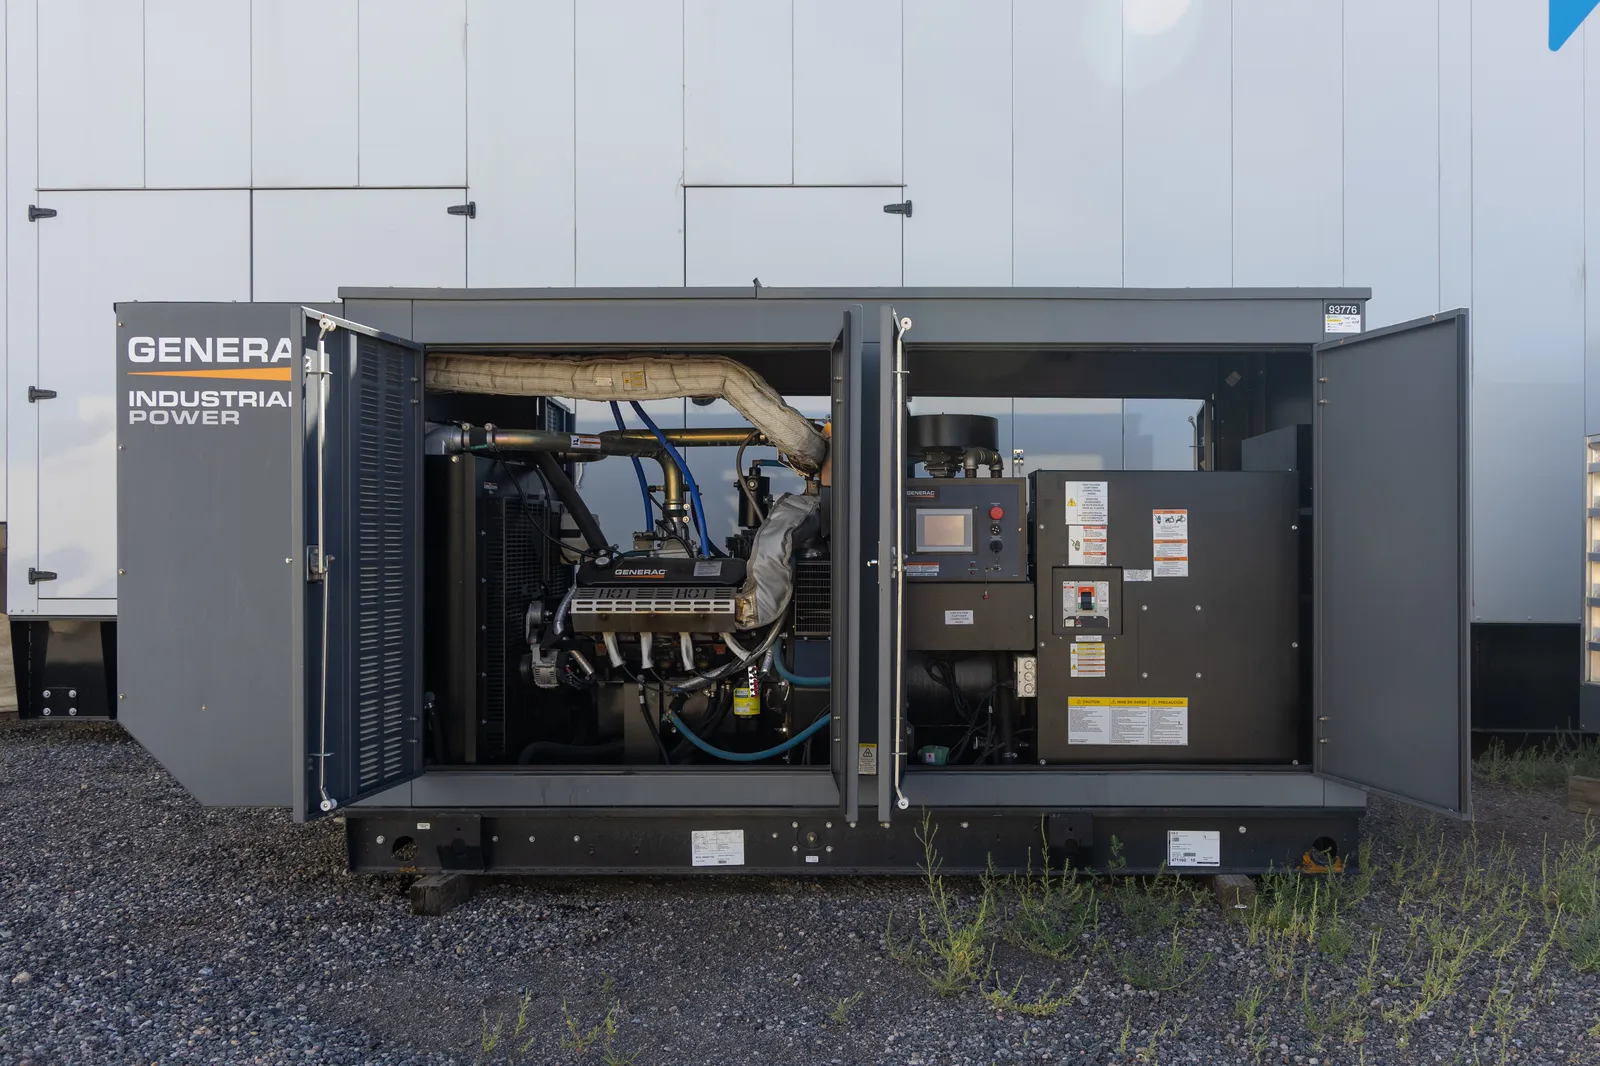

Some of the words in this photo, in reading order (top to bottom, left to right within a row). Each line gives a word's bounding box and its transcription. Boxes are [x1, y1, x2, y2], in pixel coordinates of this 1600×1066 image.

[1328, 305, 1358, 314] 93776
[128, 336, 292, 363] GENERA
[129, 410, 240, 425] POWER
[598, 588, 637, 599] HOT
[675, 588, 713, 599] HOT
